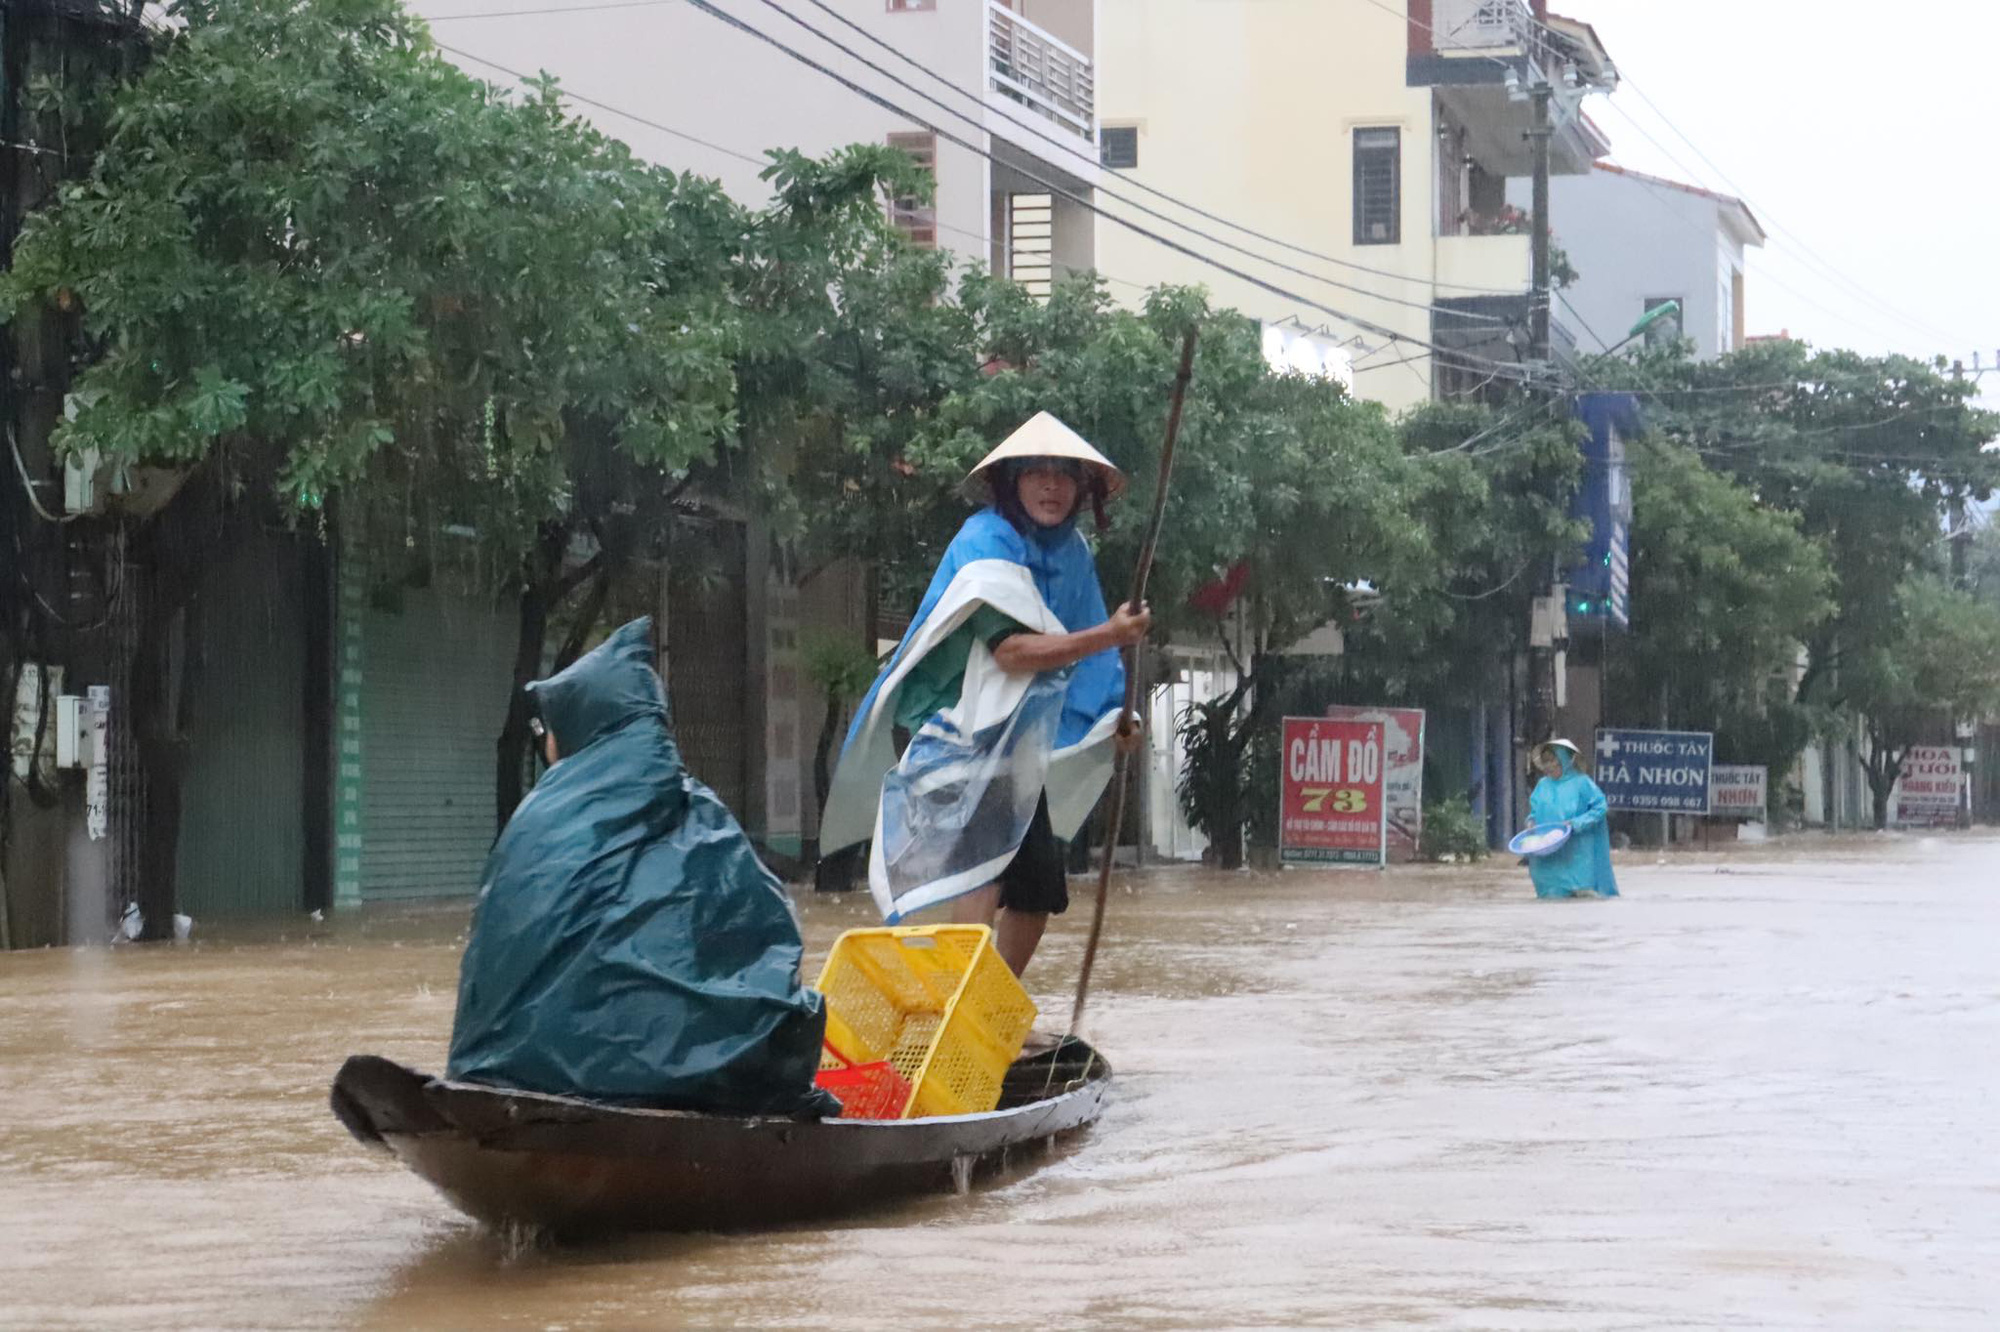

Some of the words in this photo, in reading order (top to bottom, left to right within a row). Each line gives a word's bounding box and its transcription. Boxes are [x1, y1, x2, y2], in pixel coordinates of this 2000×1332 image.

[1624, 737, 1674, 755] THUỐC
[1678, 740, 1708, 756] TÂY
[1598, 760, 1631, 783] HÀ
[1638, 764, 1704, 786] NHƠN
[1300, 788, 1367, 813] 73
